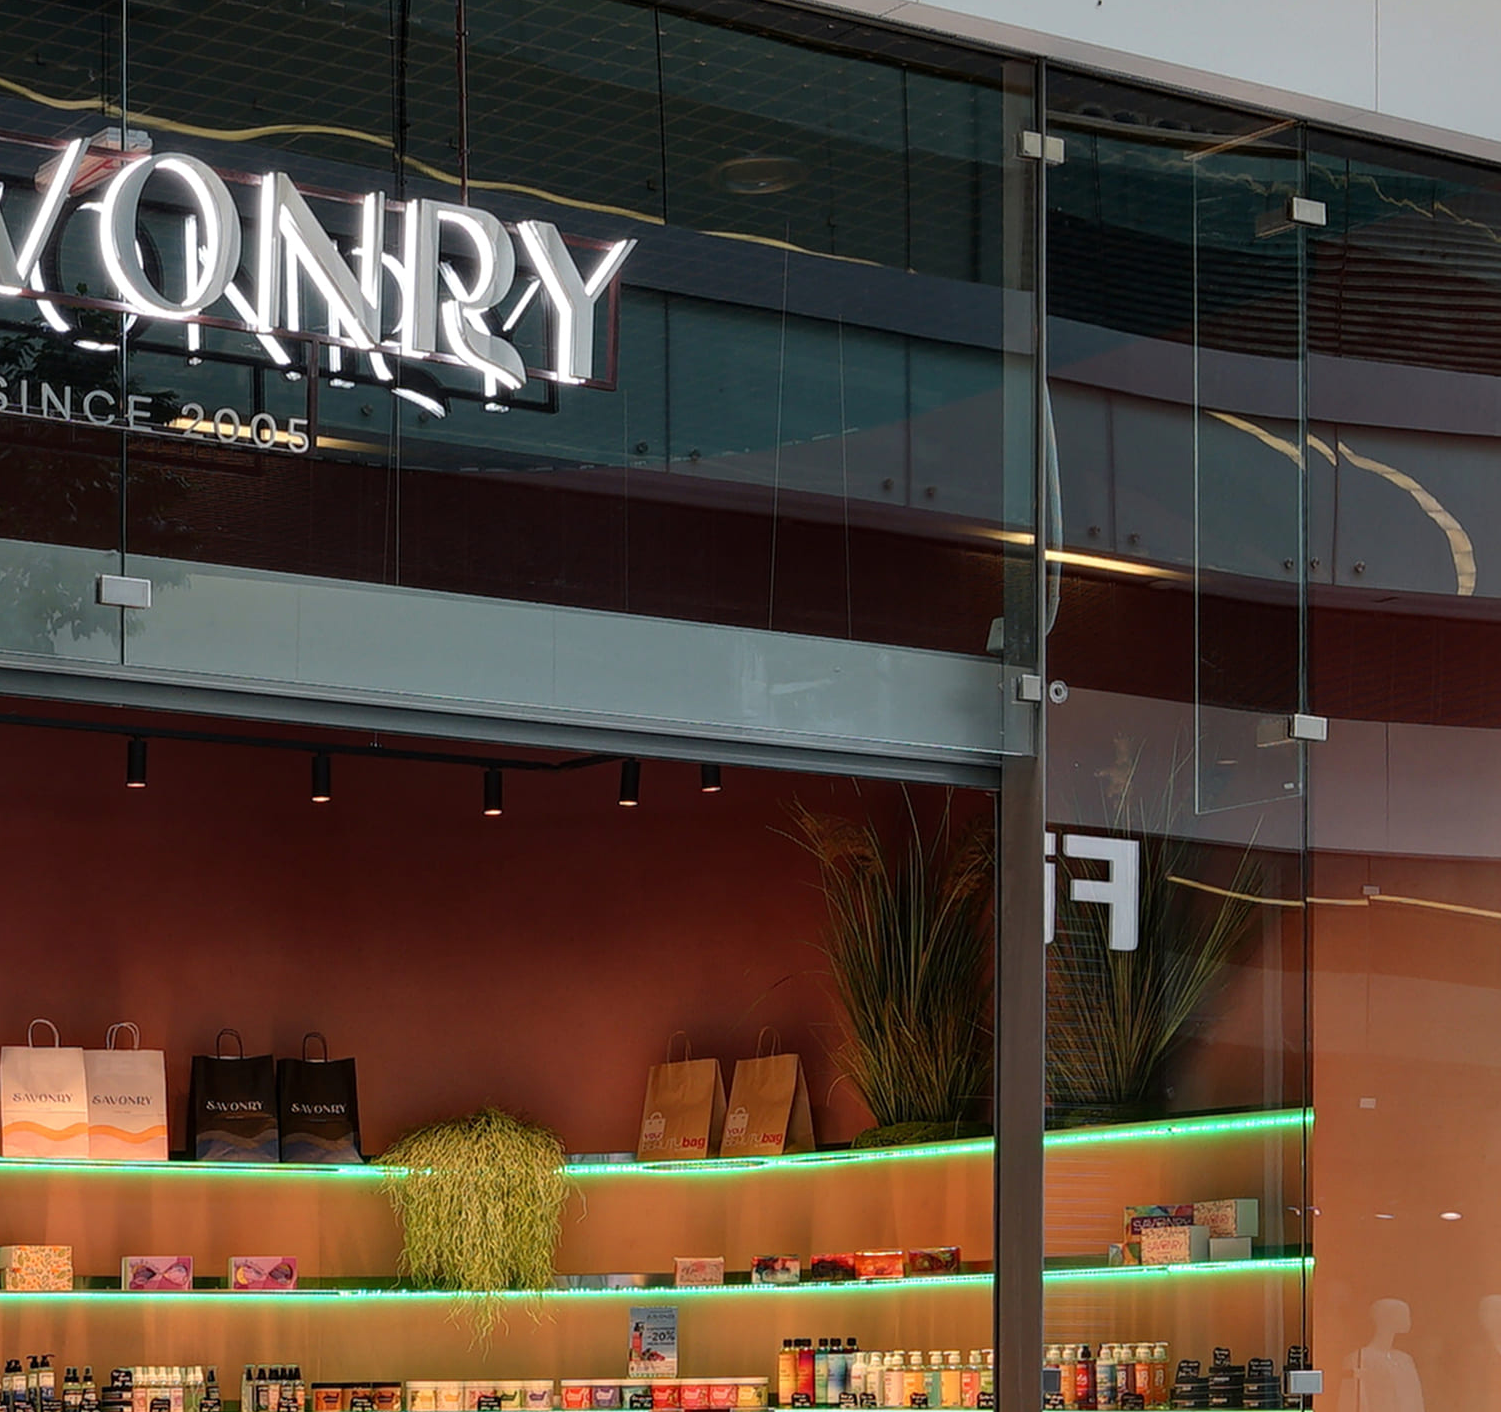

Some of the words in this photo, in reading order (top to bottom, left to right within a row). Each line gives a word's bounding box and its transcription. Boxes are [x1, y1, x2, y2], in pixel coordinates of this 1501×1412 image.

[180, 400, 312, 456] 2005
[12, 1092, 74, 1104] SAVONRY
[92, 1094, 152, 1106] SAVONRY
[206, 1100, 264, 1113] SAVONRY
[291, 1102, 347, 1115] SAVONRY
[682, 1137, 706, 1149] bag
[761, 1133, 783, 1144] bag
[648, 1331, 675, 1342] -20%
